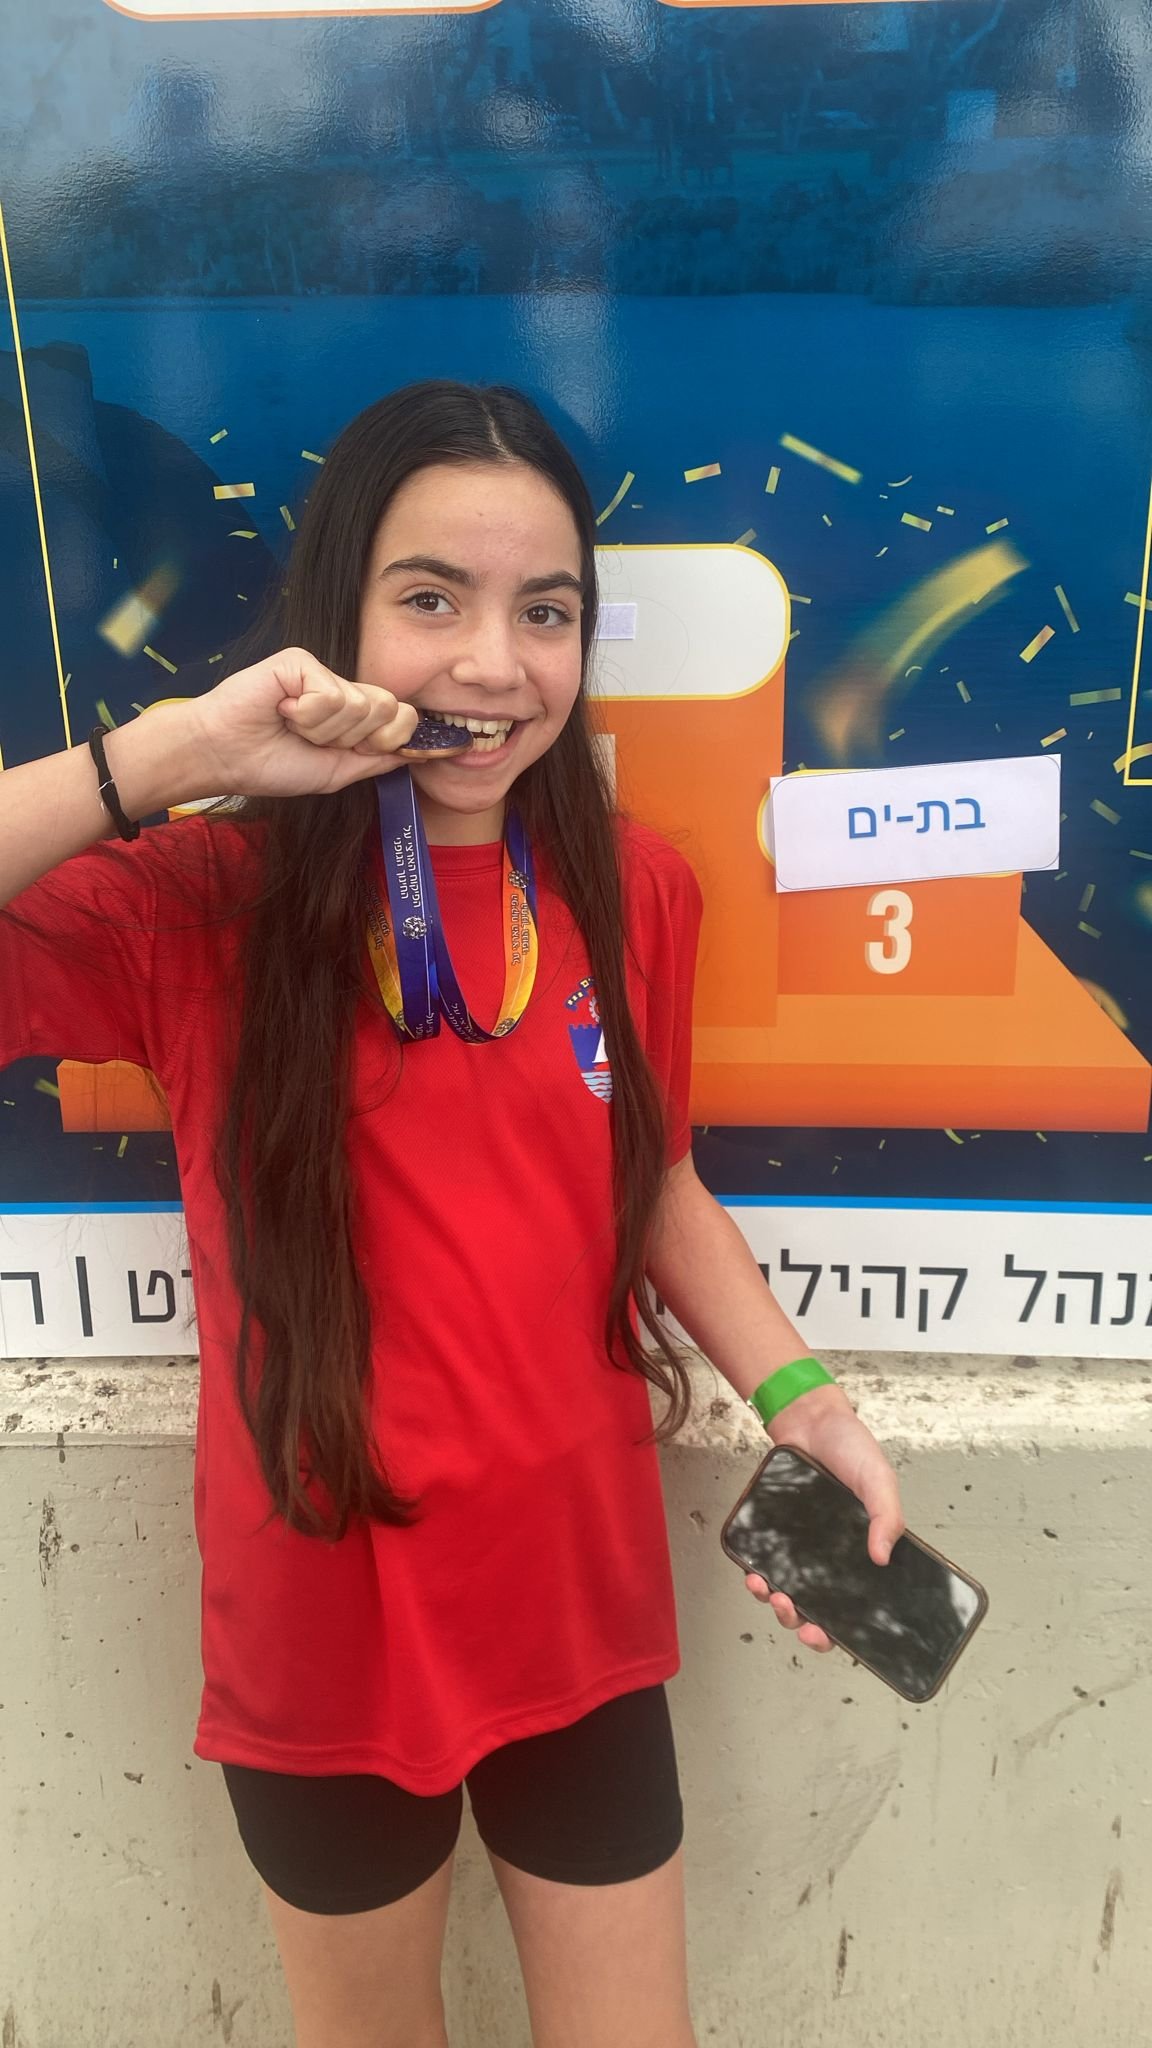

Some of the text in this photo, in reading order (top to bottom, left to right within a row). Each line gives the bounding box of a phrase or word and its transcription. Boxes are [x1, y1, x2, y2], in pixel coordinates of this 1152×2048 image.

[847, 797, 986, 839] בת-ים
[865, 890, 913, 974] 3
[757, 1247, 967, 1332] קהיל
